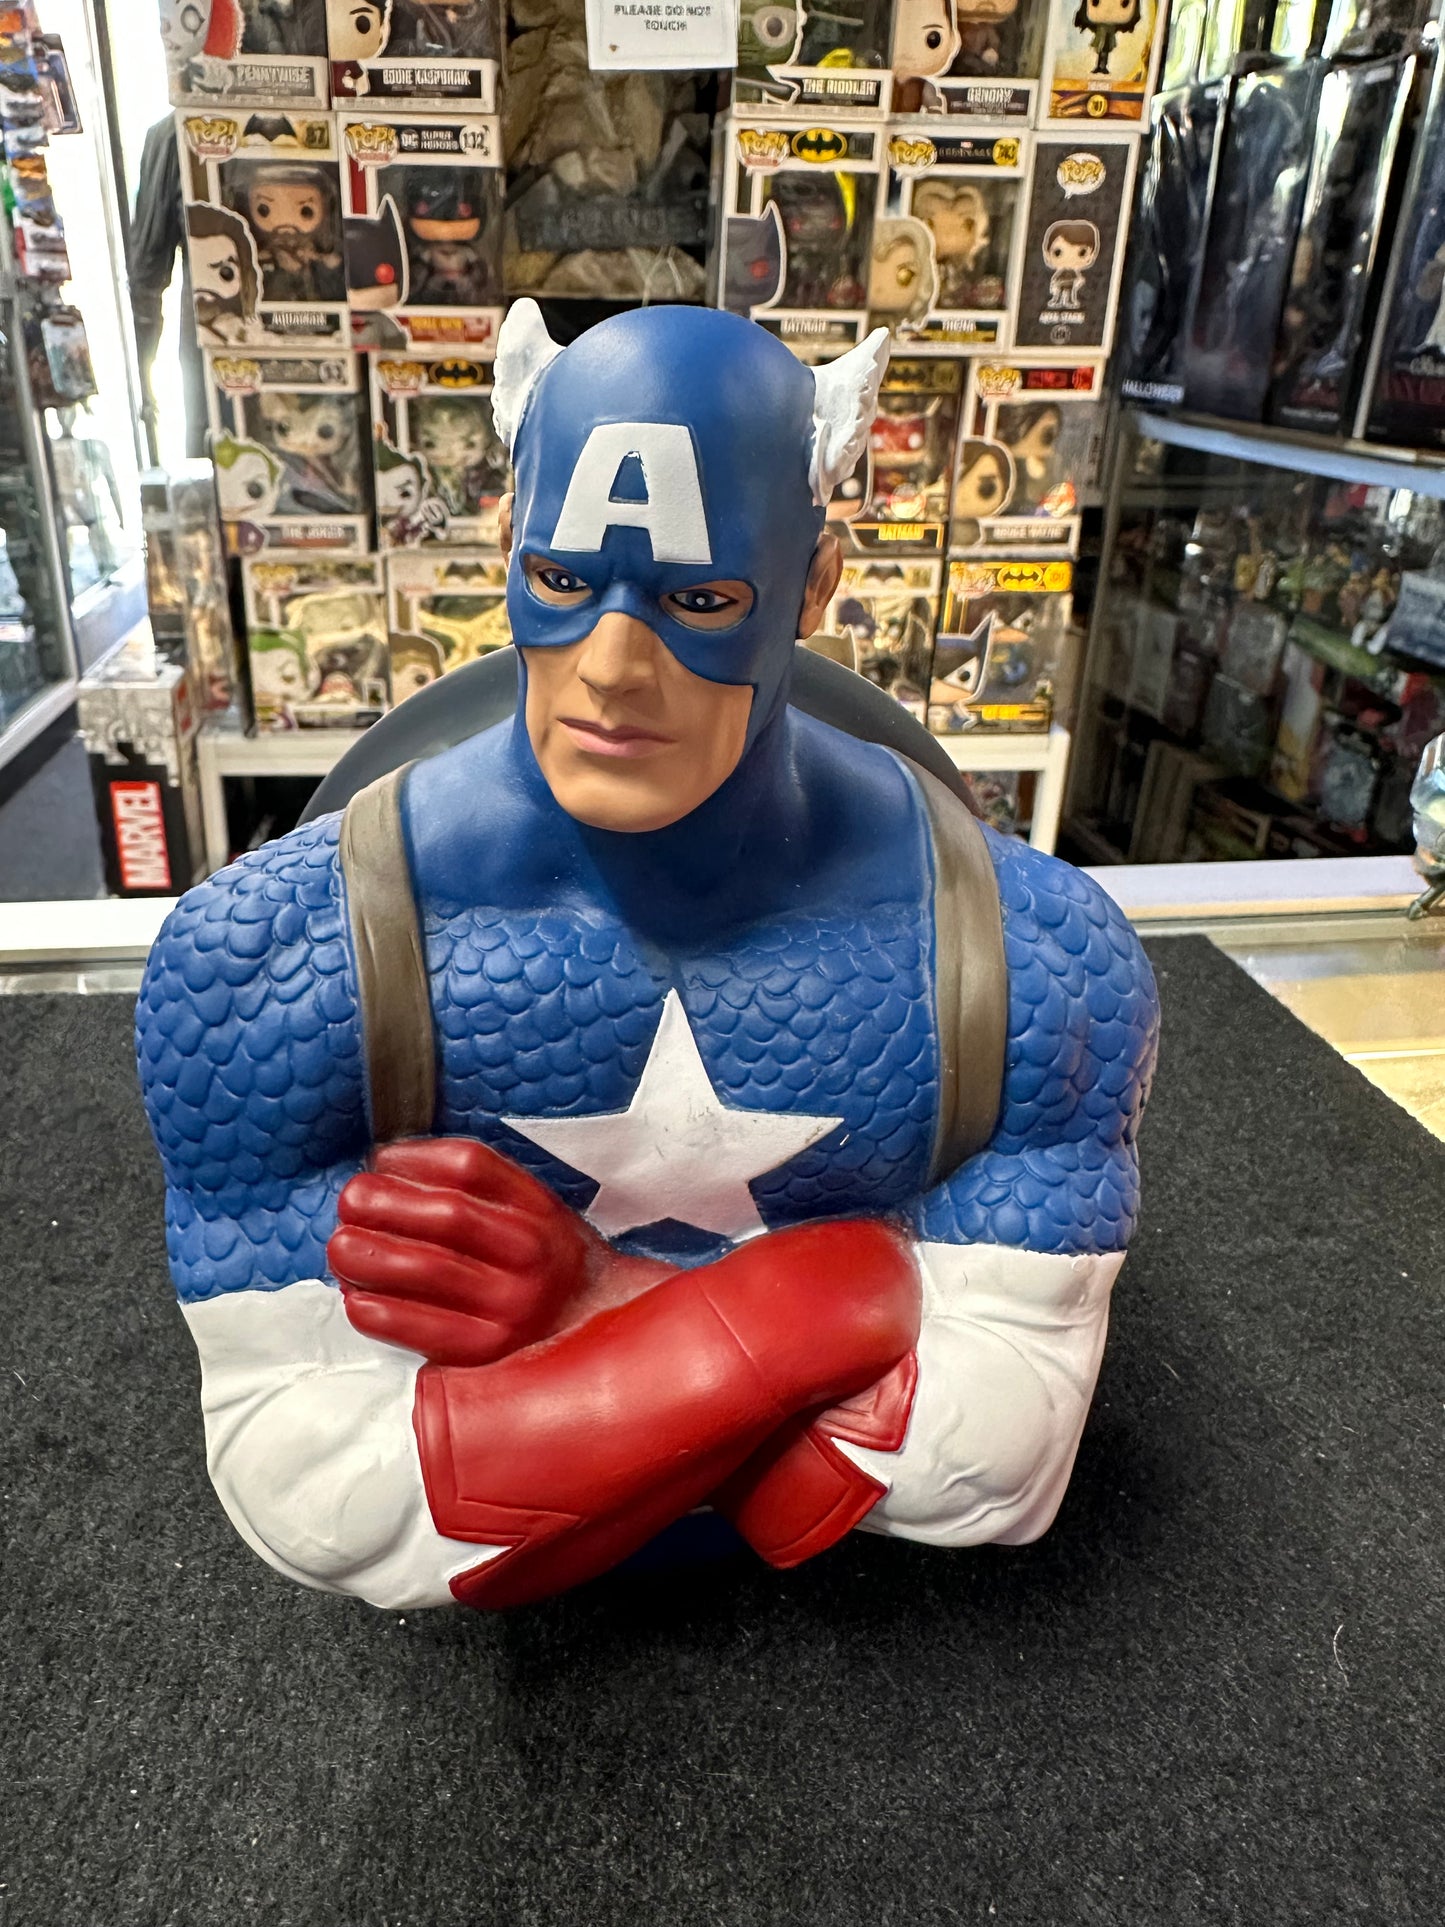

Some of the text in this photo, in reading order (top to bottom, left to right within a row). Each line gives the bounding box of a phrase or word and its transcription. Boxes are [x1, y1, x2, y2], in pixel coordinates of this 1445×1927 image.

[614, 4, 712, 16] PLEASE DO NOT
[645, 19, 687, 31] TOUCH
[236, 65, 310, 83] PENNYWISE
[803, 79, 876, 95] THE RIDDLER
[549, 422, 713, 564] A
[112, 782, 170, 889] MARVEL
